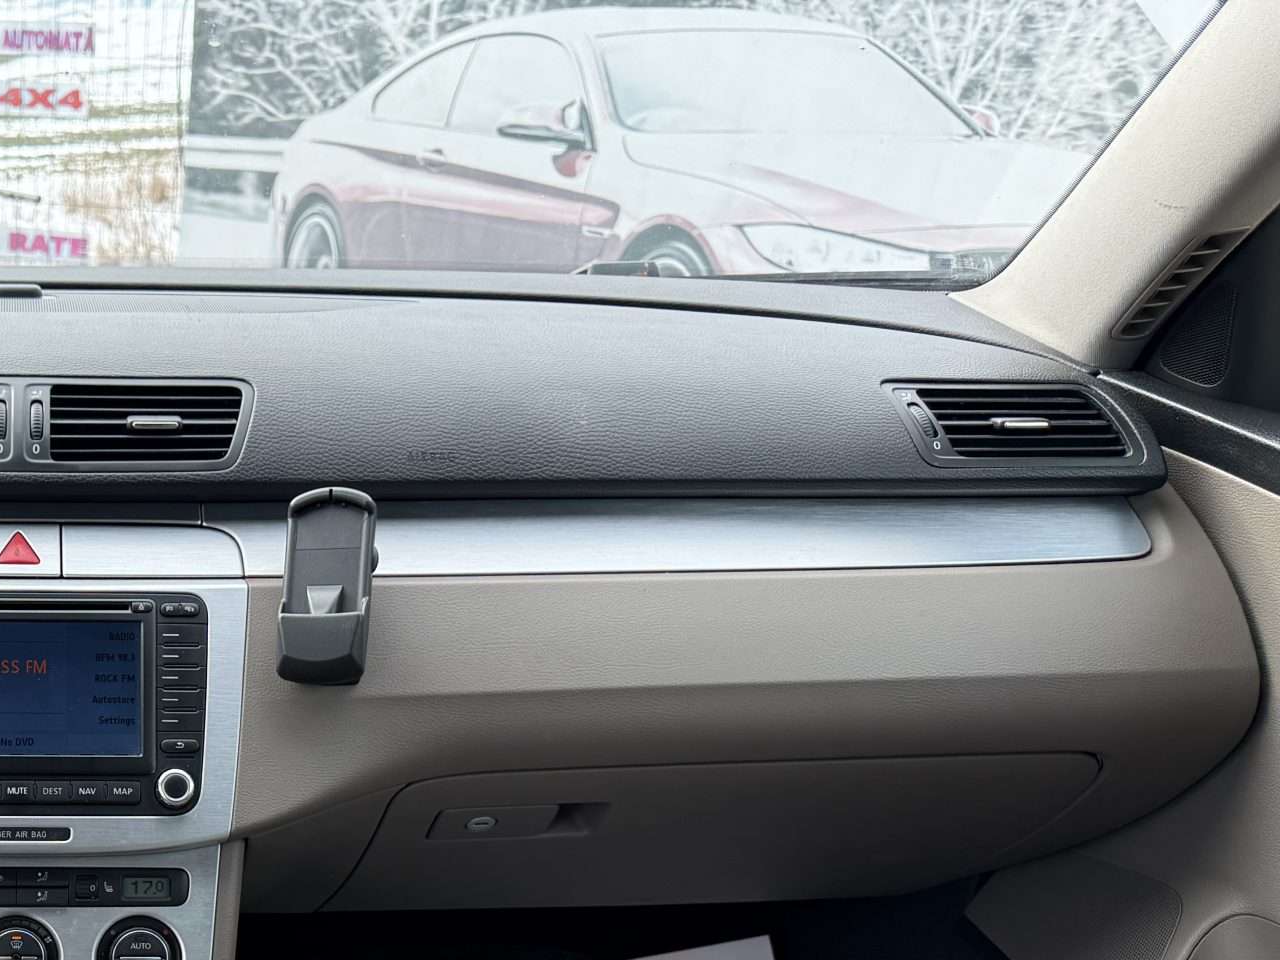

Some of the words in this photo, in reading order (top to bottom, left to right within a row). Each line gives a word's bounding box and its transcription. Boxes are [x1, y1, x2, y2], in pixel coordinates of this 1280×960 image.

[9, 232, 88, 257] RATE
[25, 658, 48, 674] FM
[97, 714, 137, 727] Settings
[0, 737, 13, 747] No
[15, 737, 35, 747] DVD
[7, 786, 28, 795] MUTE
[42, 787, 63, 796] DEST
[78, 787, 97, 796] NAV
[113, 787, 133, 796] MAP
[15, 830, 28, 839] AIR
[31, 830, 47, 839] BAG
[130, 880, 165, 896] 17.0
[130, 942, 152, 950] AUTO
